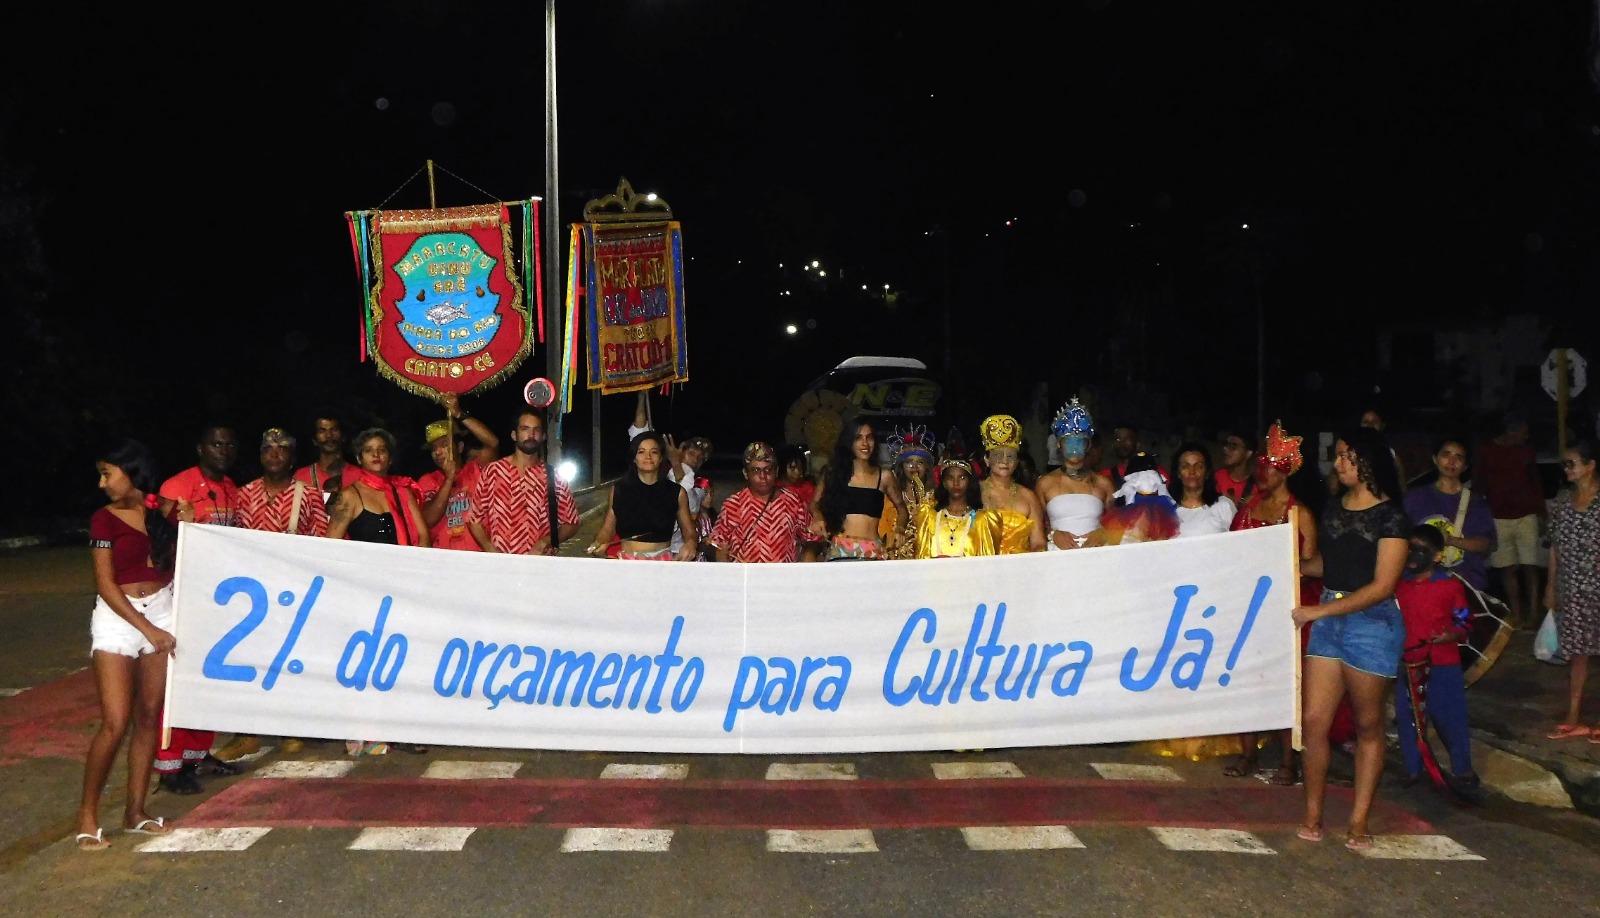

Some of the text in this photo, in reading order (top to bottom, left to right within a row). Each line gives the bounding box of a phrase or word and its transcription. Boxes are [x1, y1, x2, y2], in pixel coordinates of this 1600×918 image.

[400, 242, 492, 276] MARACATU
[204, 576, 324, 690] 2%
[337, 596, 408, 691] do
[434, 616, 704, 713] orçamento
[724, 656, 851, 732] para
[883, 603, 1092, 706] Cultura
